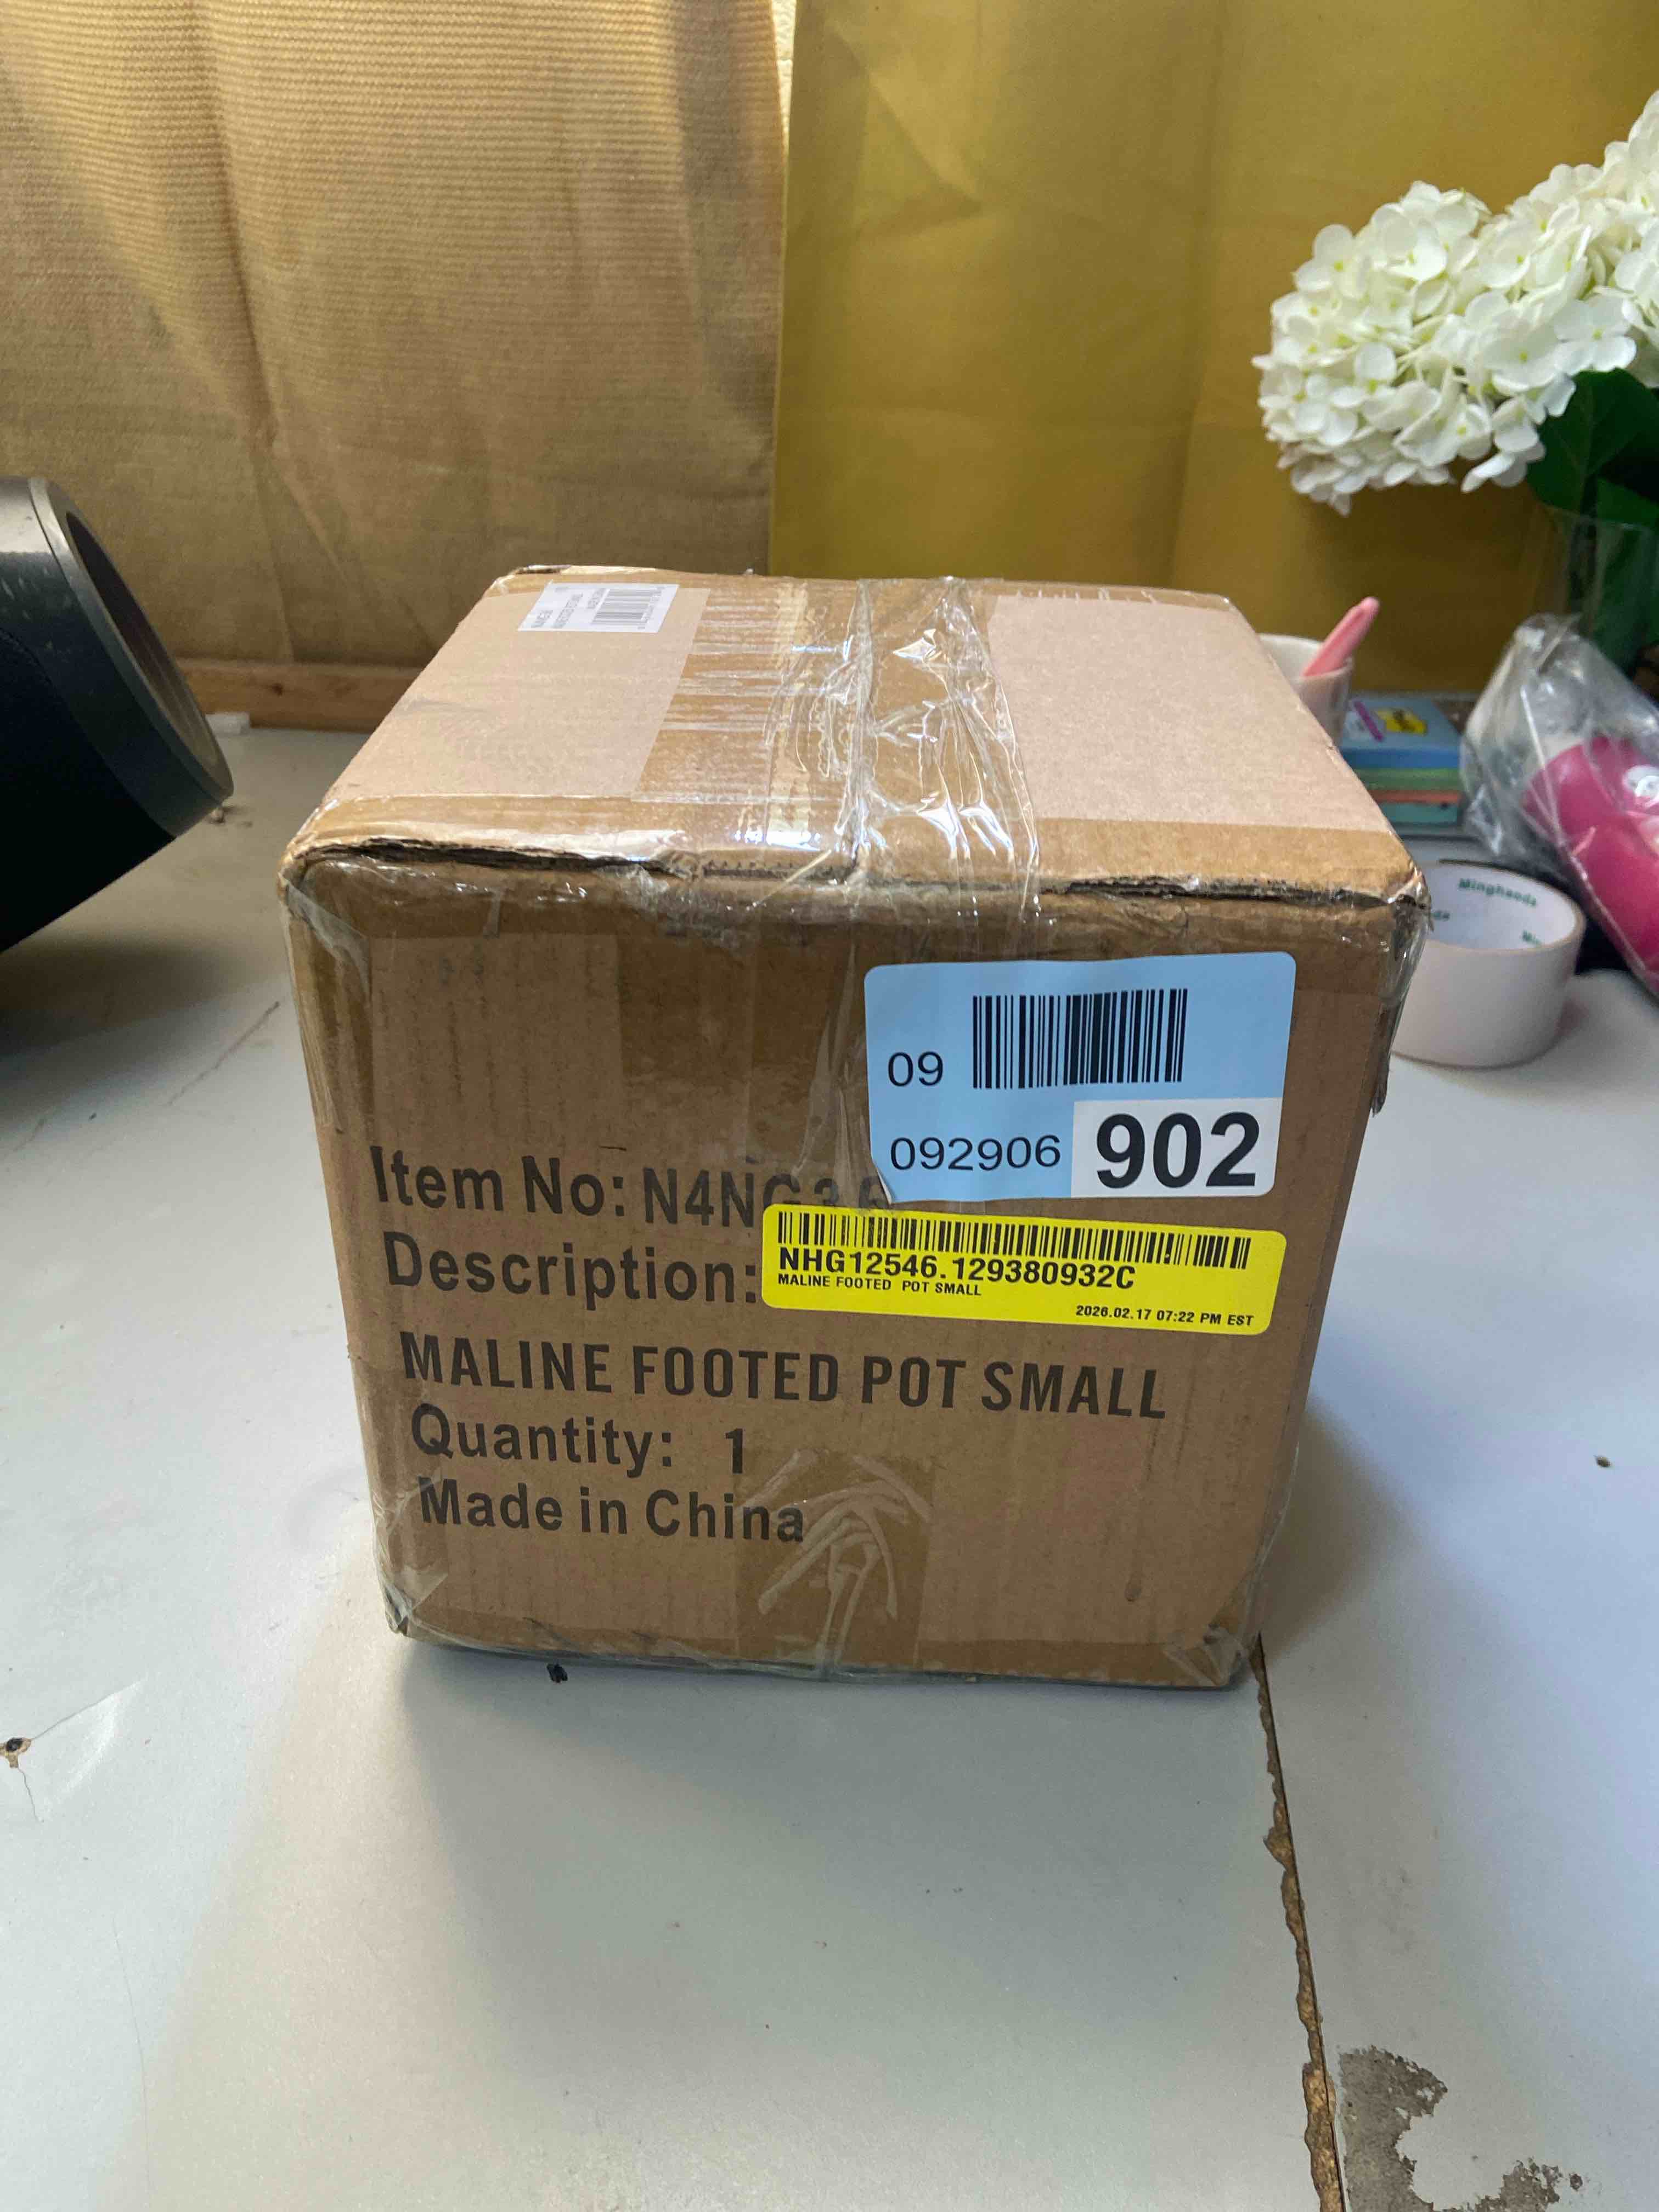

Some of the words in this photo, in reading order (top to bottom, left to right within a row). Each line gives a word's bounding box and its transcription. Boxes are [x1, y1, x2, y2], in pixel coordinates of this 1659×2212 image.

[888, 1051, 944, 1086] 09
[370, 1146, 504, 1211] Item
[522, 1155, 625, 1216] No:
[890, 1135, 1061, 1171] 092906
[1097, 1111, 1260, 1189] 902
[384, 1231, 757, 1311] Description:
[778, 1246, 1136, 1289] NHG12546.129380932C
[778, 1273, 830, 1287] MALINE
[836, 1277, 891, 1291] FOOTED
[902, 1280, 930, 1293] POT
[934, 1282, 982, 1296] SMALL
[1076, 1305, 1151, 1321] 2026.02.17
[1156, 1310, 1194, 1323] 07:22
[1200, 1313, 1221, 1325] PM
[1227, 1314, 1254, 1327] EST
[399, 1331, 612, 1394] MALINE
[633, 1345, 839, 1403] FOOTED
[861, 1355, 966, 1408] POT
[980, 1361, 1166, 1420] SMALL
[411, 1402, 672, 1479] Quantity:
[725, 1427, 743, 1474] 1
[418, 1475, 563, 1532] Made
[580, 1486, 628, 1534] in
[645, 1489, 804, 1543] China
